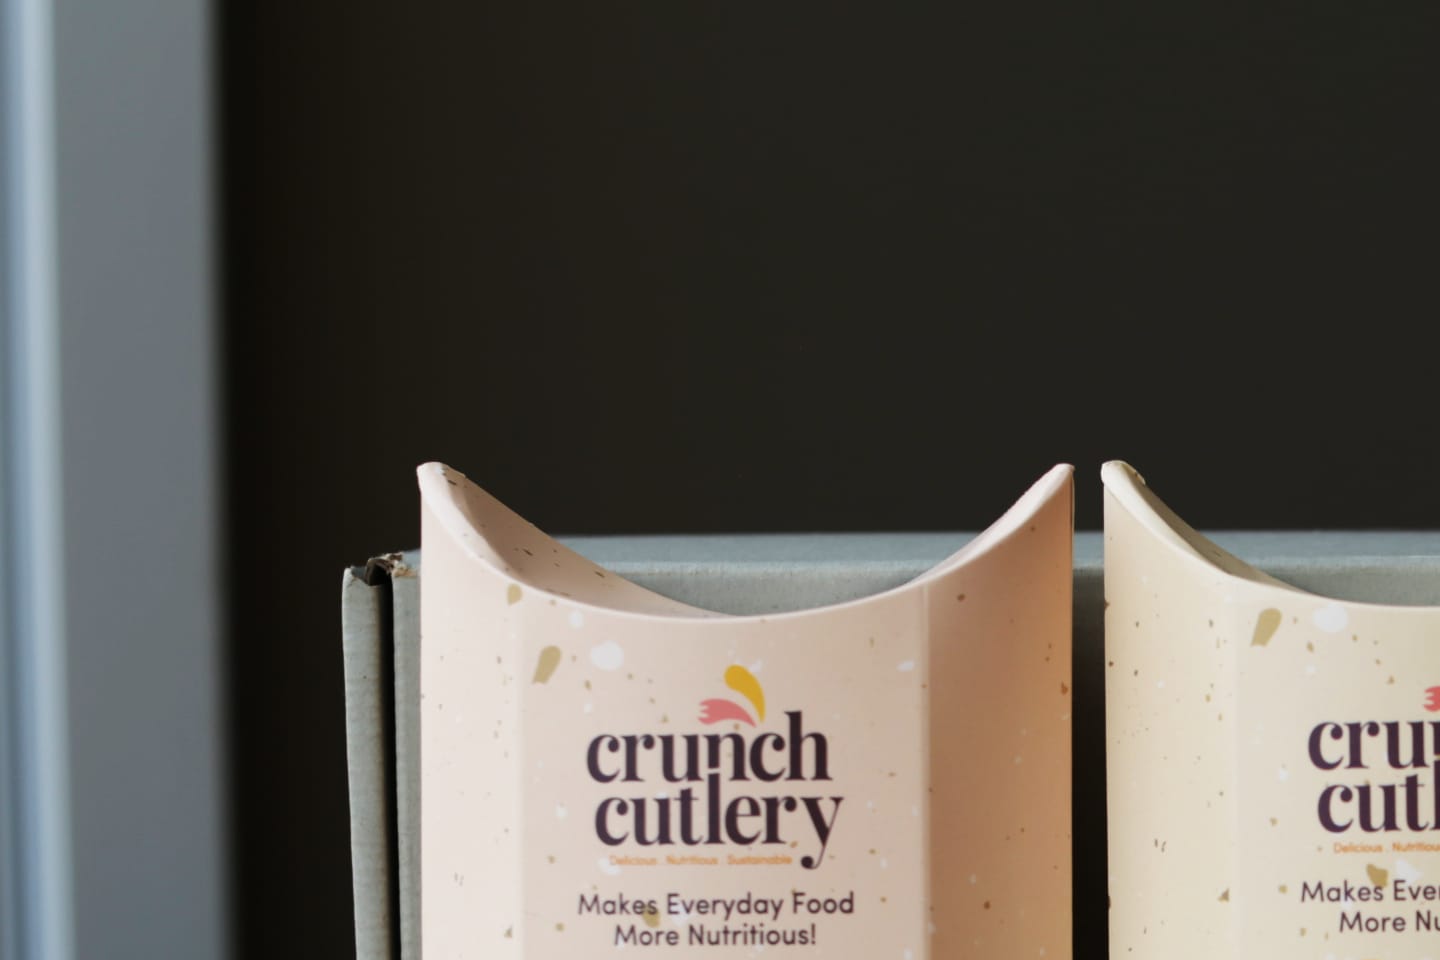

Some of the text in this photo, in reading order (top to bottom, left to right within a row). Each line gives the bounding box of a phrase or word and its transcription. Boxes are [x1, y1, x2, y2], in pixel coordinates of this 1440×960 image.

[586, 710, 833, 783] crunch
[594, 772, 844, 869] cutlery
[1301, 880, 1383, 902] Makes
[577, 891, 855, 921] Makes Everyday Food
[614, 922, 817, 946] More Nutritious!
[1339, 911, 1406, 932] More
